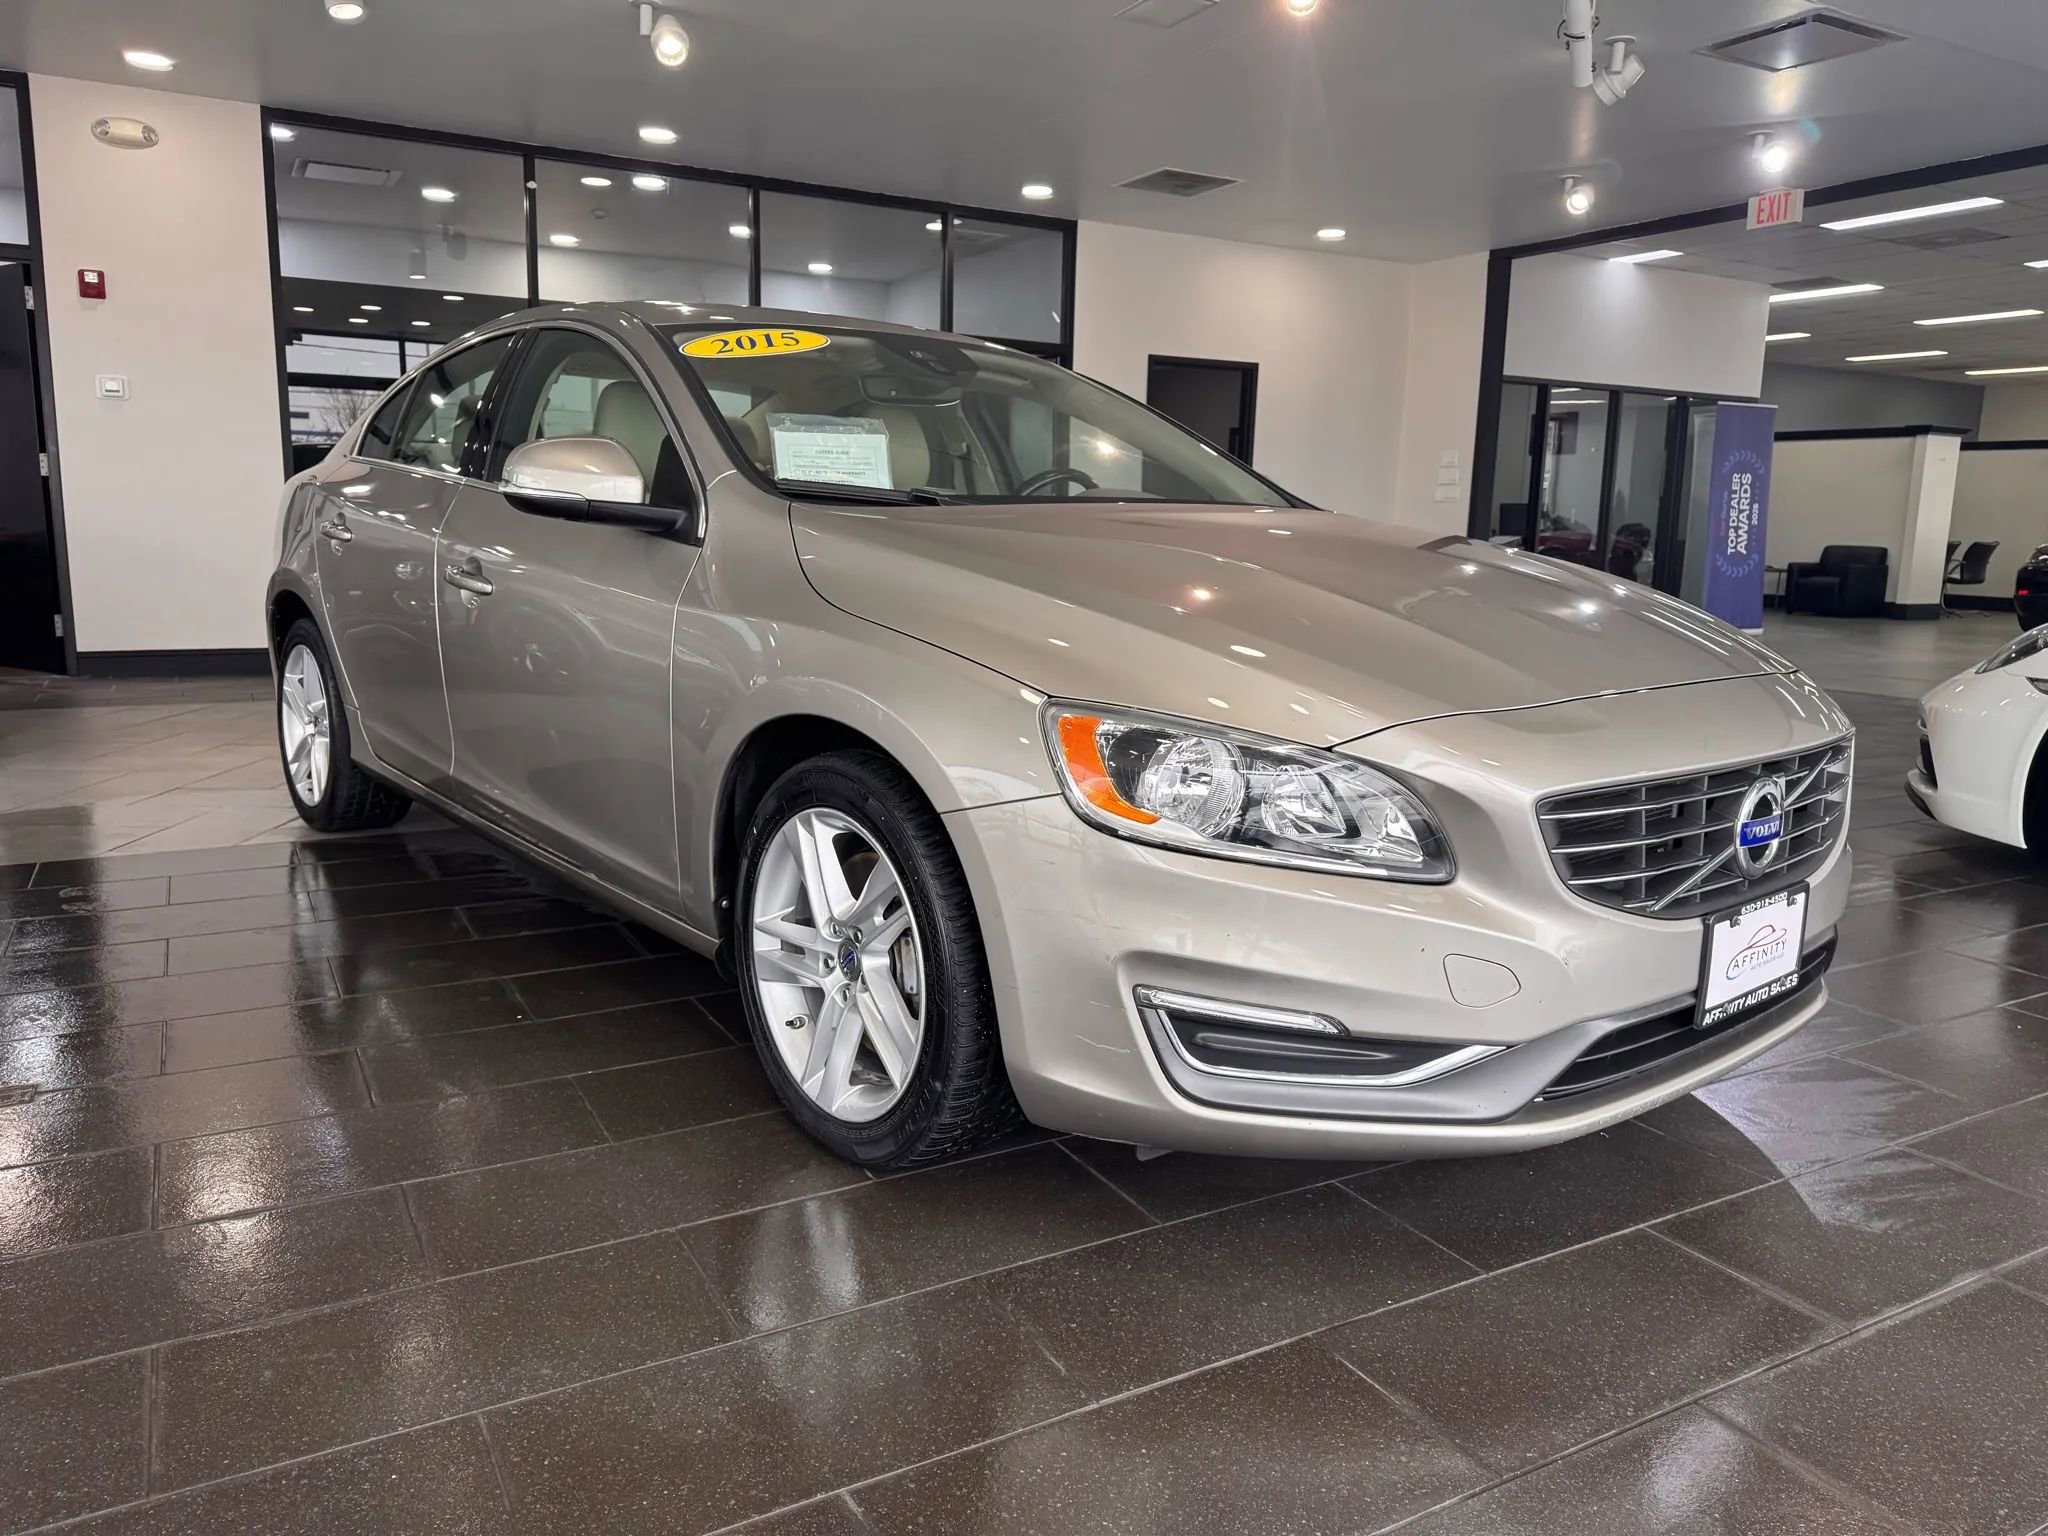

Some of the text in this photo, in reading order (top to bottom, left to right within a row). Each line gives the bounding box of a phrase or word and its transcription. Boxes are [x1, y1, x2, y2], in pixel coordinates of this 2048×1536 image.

[1756, 192, 1792, 224] EXIT
[711, 332, 800, 354] 2015
[1727, 473, 1741, 555] TOP DEALER
[1736, 473, 1752, 555] AWARDS
[1741, 892, 1788, 915] 630-912-4500
[1733, 939, 1787, 970] AFFINITY
[1745, 987, 1769, 1007] AUTO
